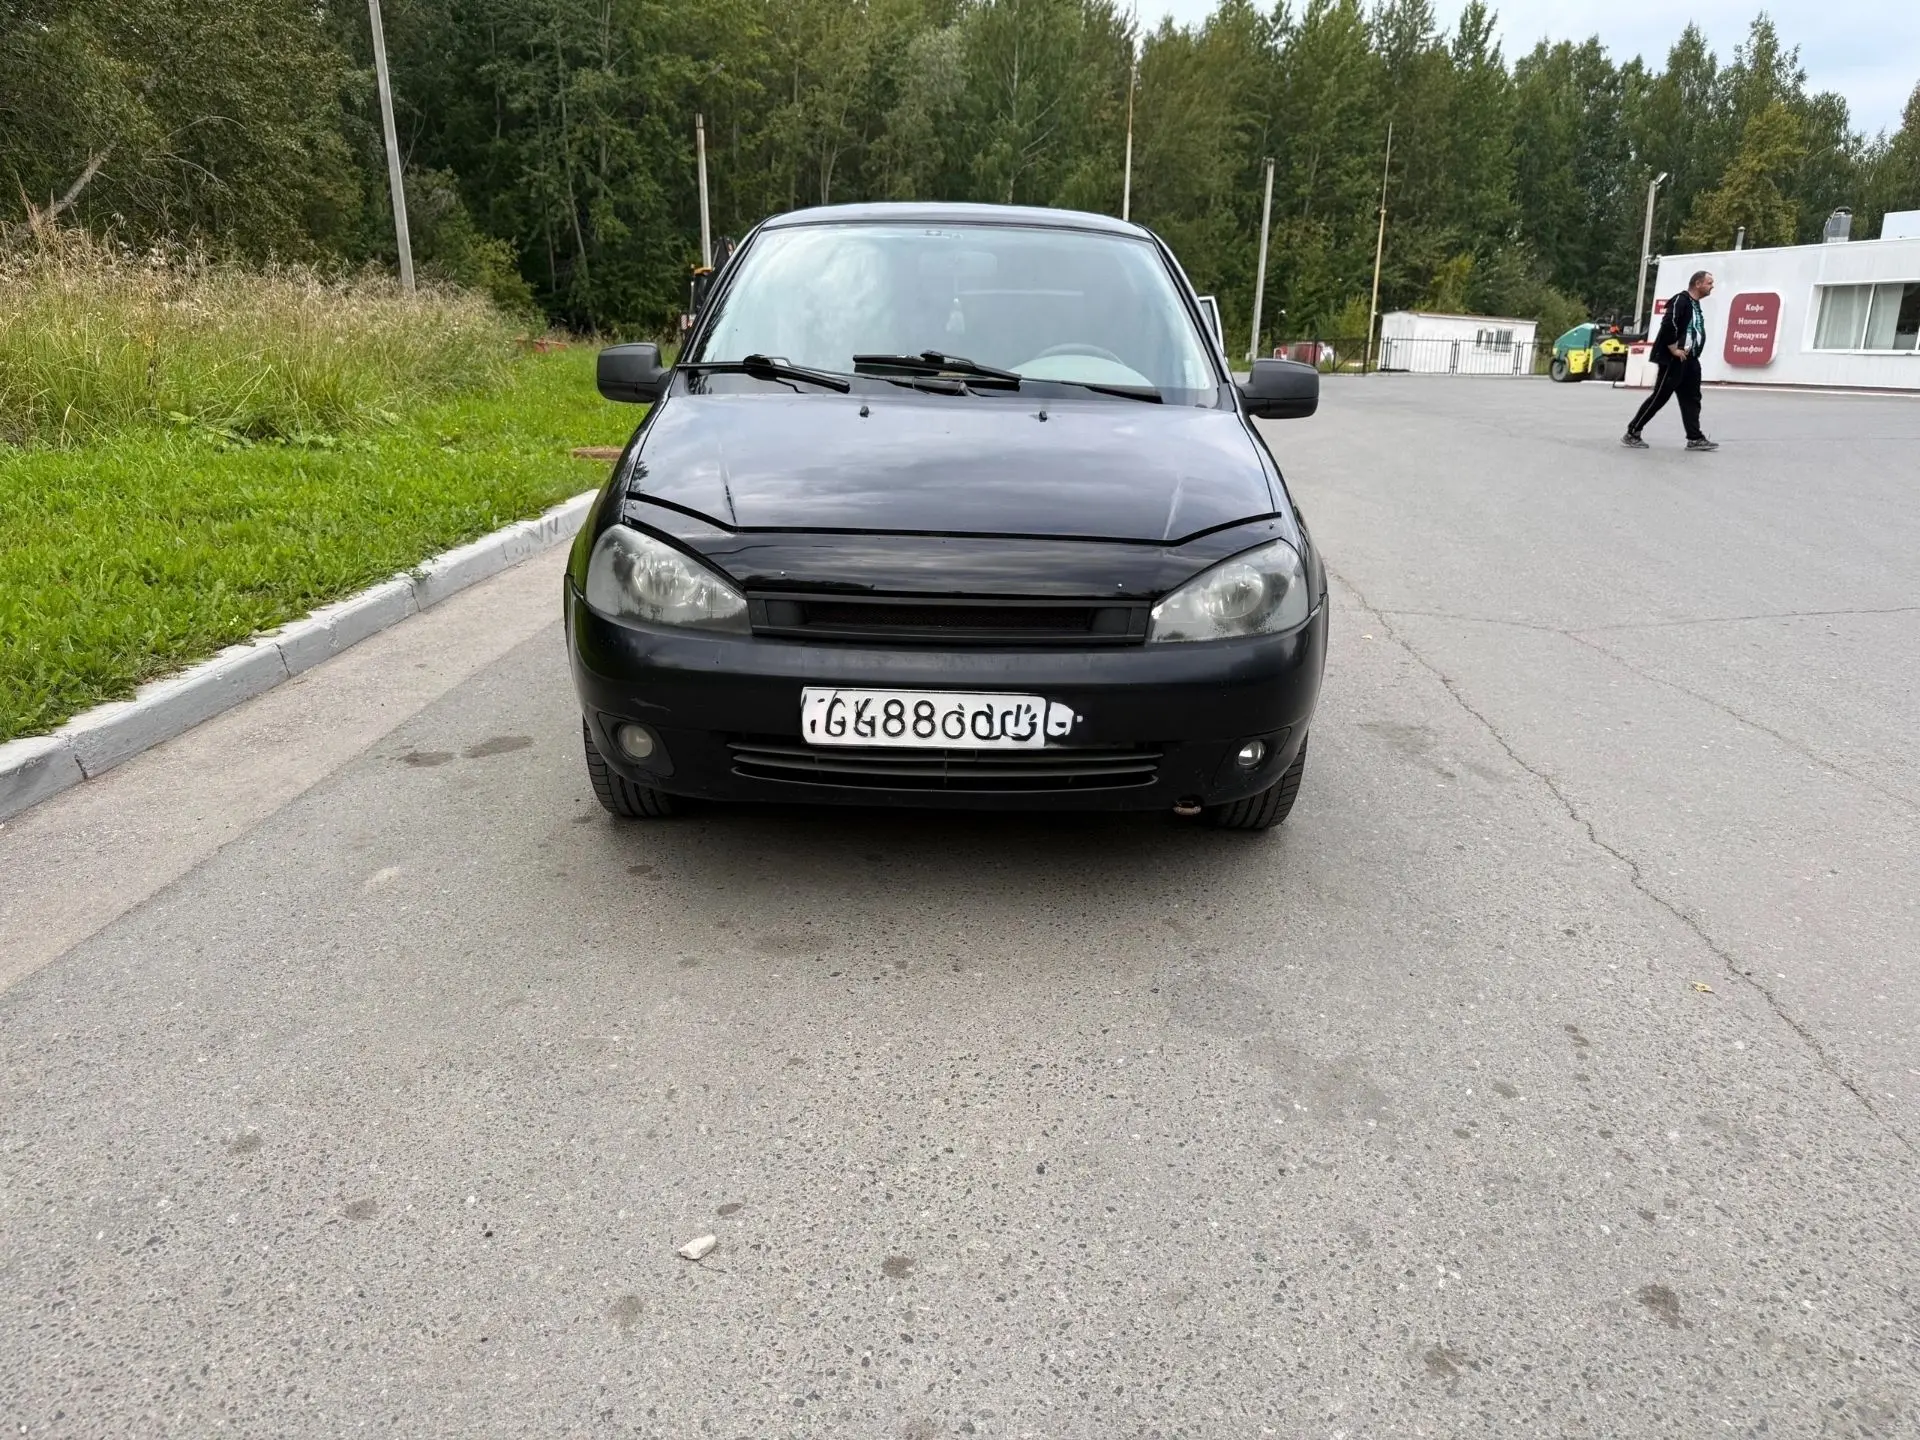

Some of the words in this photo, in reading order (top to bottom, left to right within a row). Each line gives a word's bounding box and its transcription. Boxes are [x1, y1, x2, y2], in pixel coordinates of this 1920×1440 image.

[1738, 317, 1768, 325] Напитки
[1733, 331, 1768, 340] Продукты
[1732, 344, 1764, 354] Телефон
